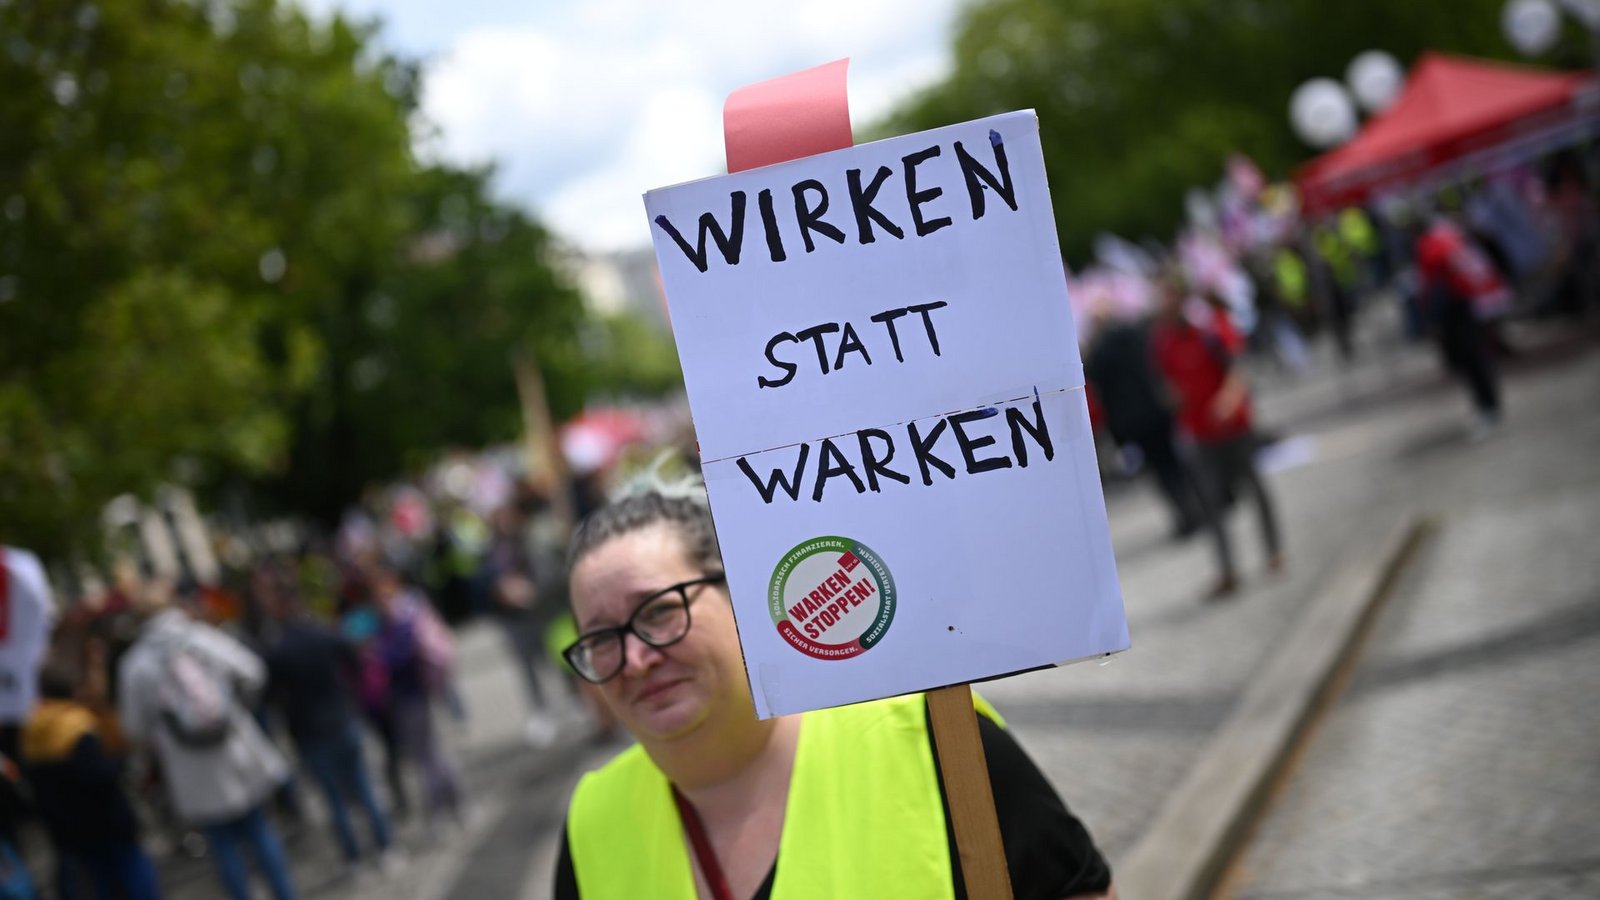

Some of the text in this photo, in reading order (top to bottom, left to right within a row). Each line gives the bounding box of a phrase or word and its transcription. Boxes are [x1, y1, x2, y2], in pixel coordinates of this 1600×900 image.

[655, 129, 1018, 273] WIRKEN
[757, 301, 948, 389] STATT
[736, 385, 1054, 504] WARKEN
[788, 569, 852, 623] WARKEN
[803, 577, 876, 640] STOPPEN!
[866, 596, 892, 643] SOZIALSTAAT
[783, 627, 809, 650] SICHER
